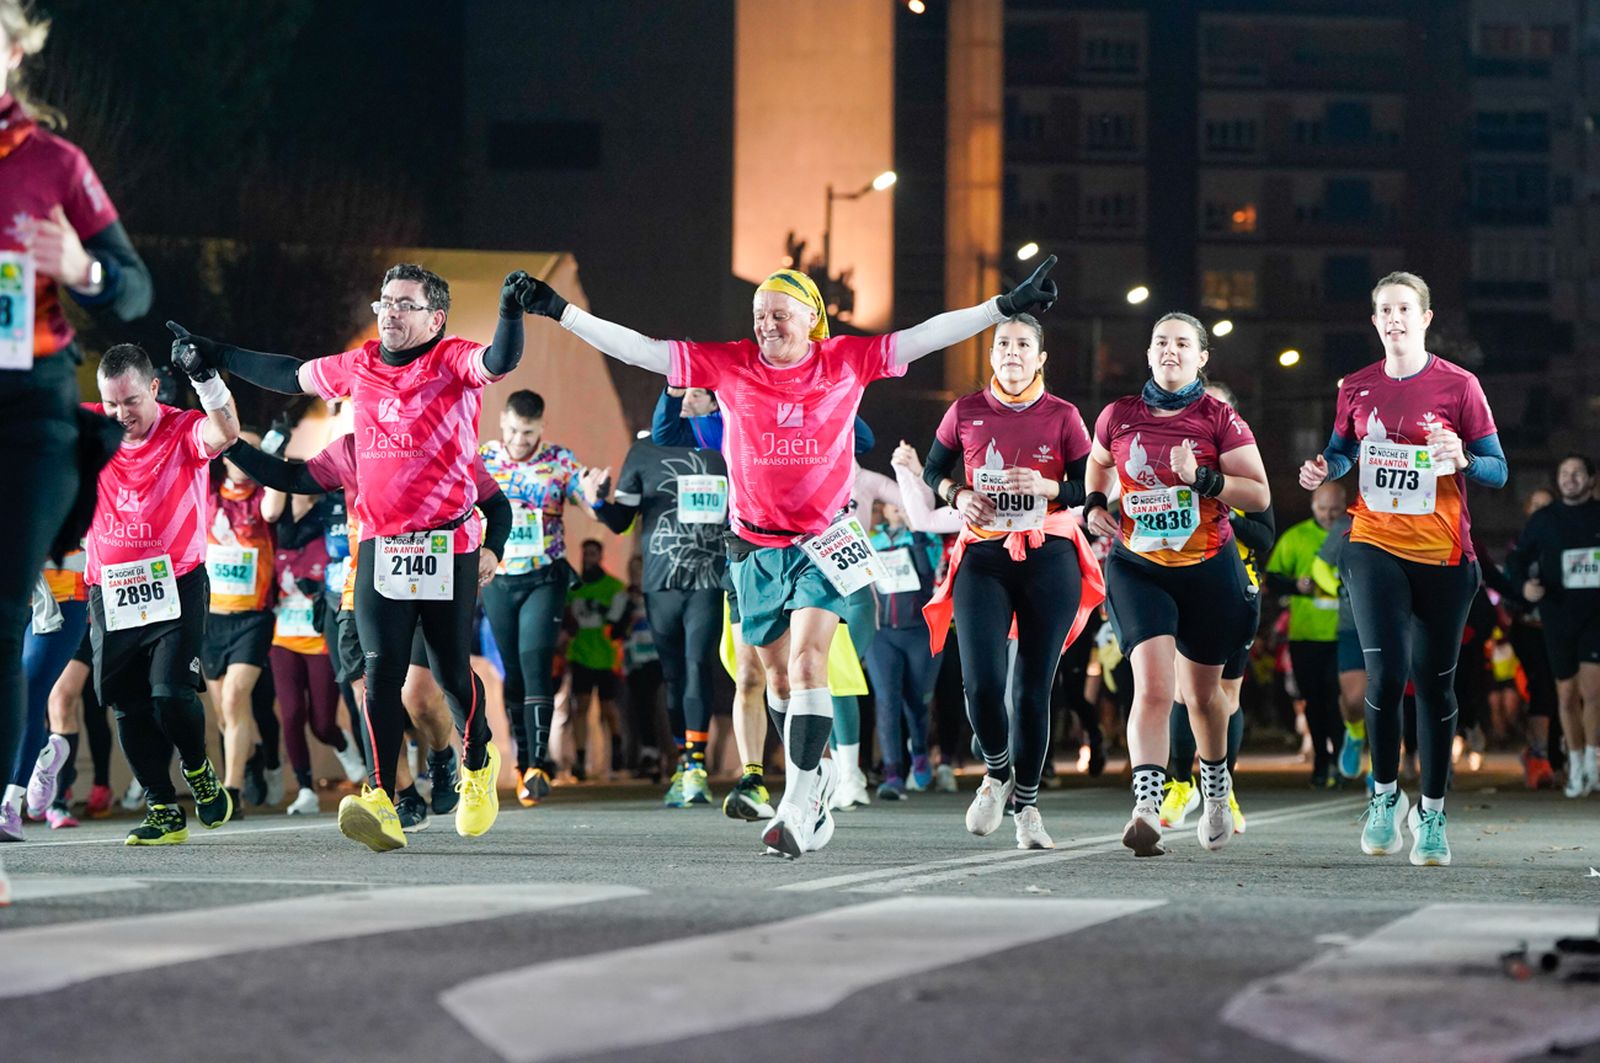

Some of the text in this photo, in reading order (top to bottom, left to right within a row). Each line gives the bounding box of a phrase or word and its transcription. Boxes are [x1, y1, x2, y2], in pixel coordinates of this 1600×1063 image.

[364, 426, 413, 450] Jaén
[762, 432, 818, 456] Jaén
[388, 450, 425, 459] INTERIOR
[790, 456, 828, 465] INTERIOR
[1368, 457, 1383, 466] SAN
[1377, 450, 1398, 459] NOCHE
[1136, 470, 1156, 487] 43
[1375, 467, 1420, 491] 6773
[691, 492, 720, 507] 1470
[986, 491, 1035, 512] 5090
[1132, 505, 1147, 514] SAN
[104, 512, 152, 539] Jaén
[125, 539, 163, 548] INTERIOR
[821, 531, 842, 547] NOCHE
[384, 546, 399, 554] SAN
[819, 545, 835, 558] SAN
[830, 539, 873, 570] 3334
[215, 563, 248, 579] 5542
[391, 555, 437, 576] 2140
[115, 569, 135, 579] NOCHE
[136, 568, 145, 576] DE
[108, 579, 123, 588] SAN
[116, 581, 165, 607] 2896
